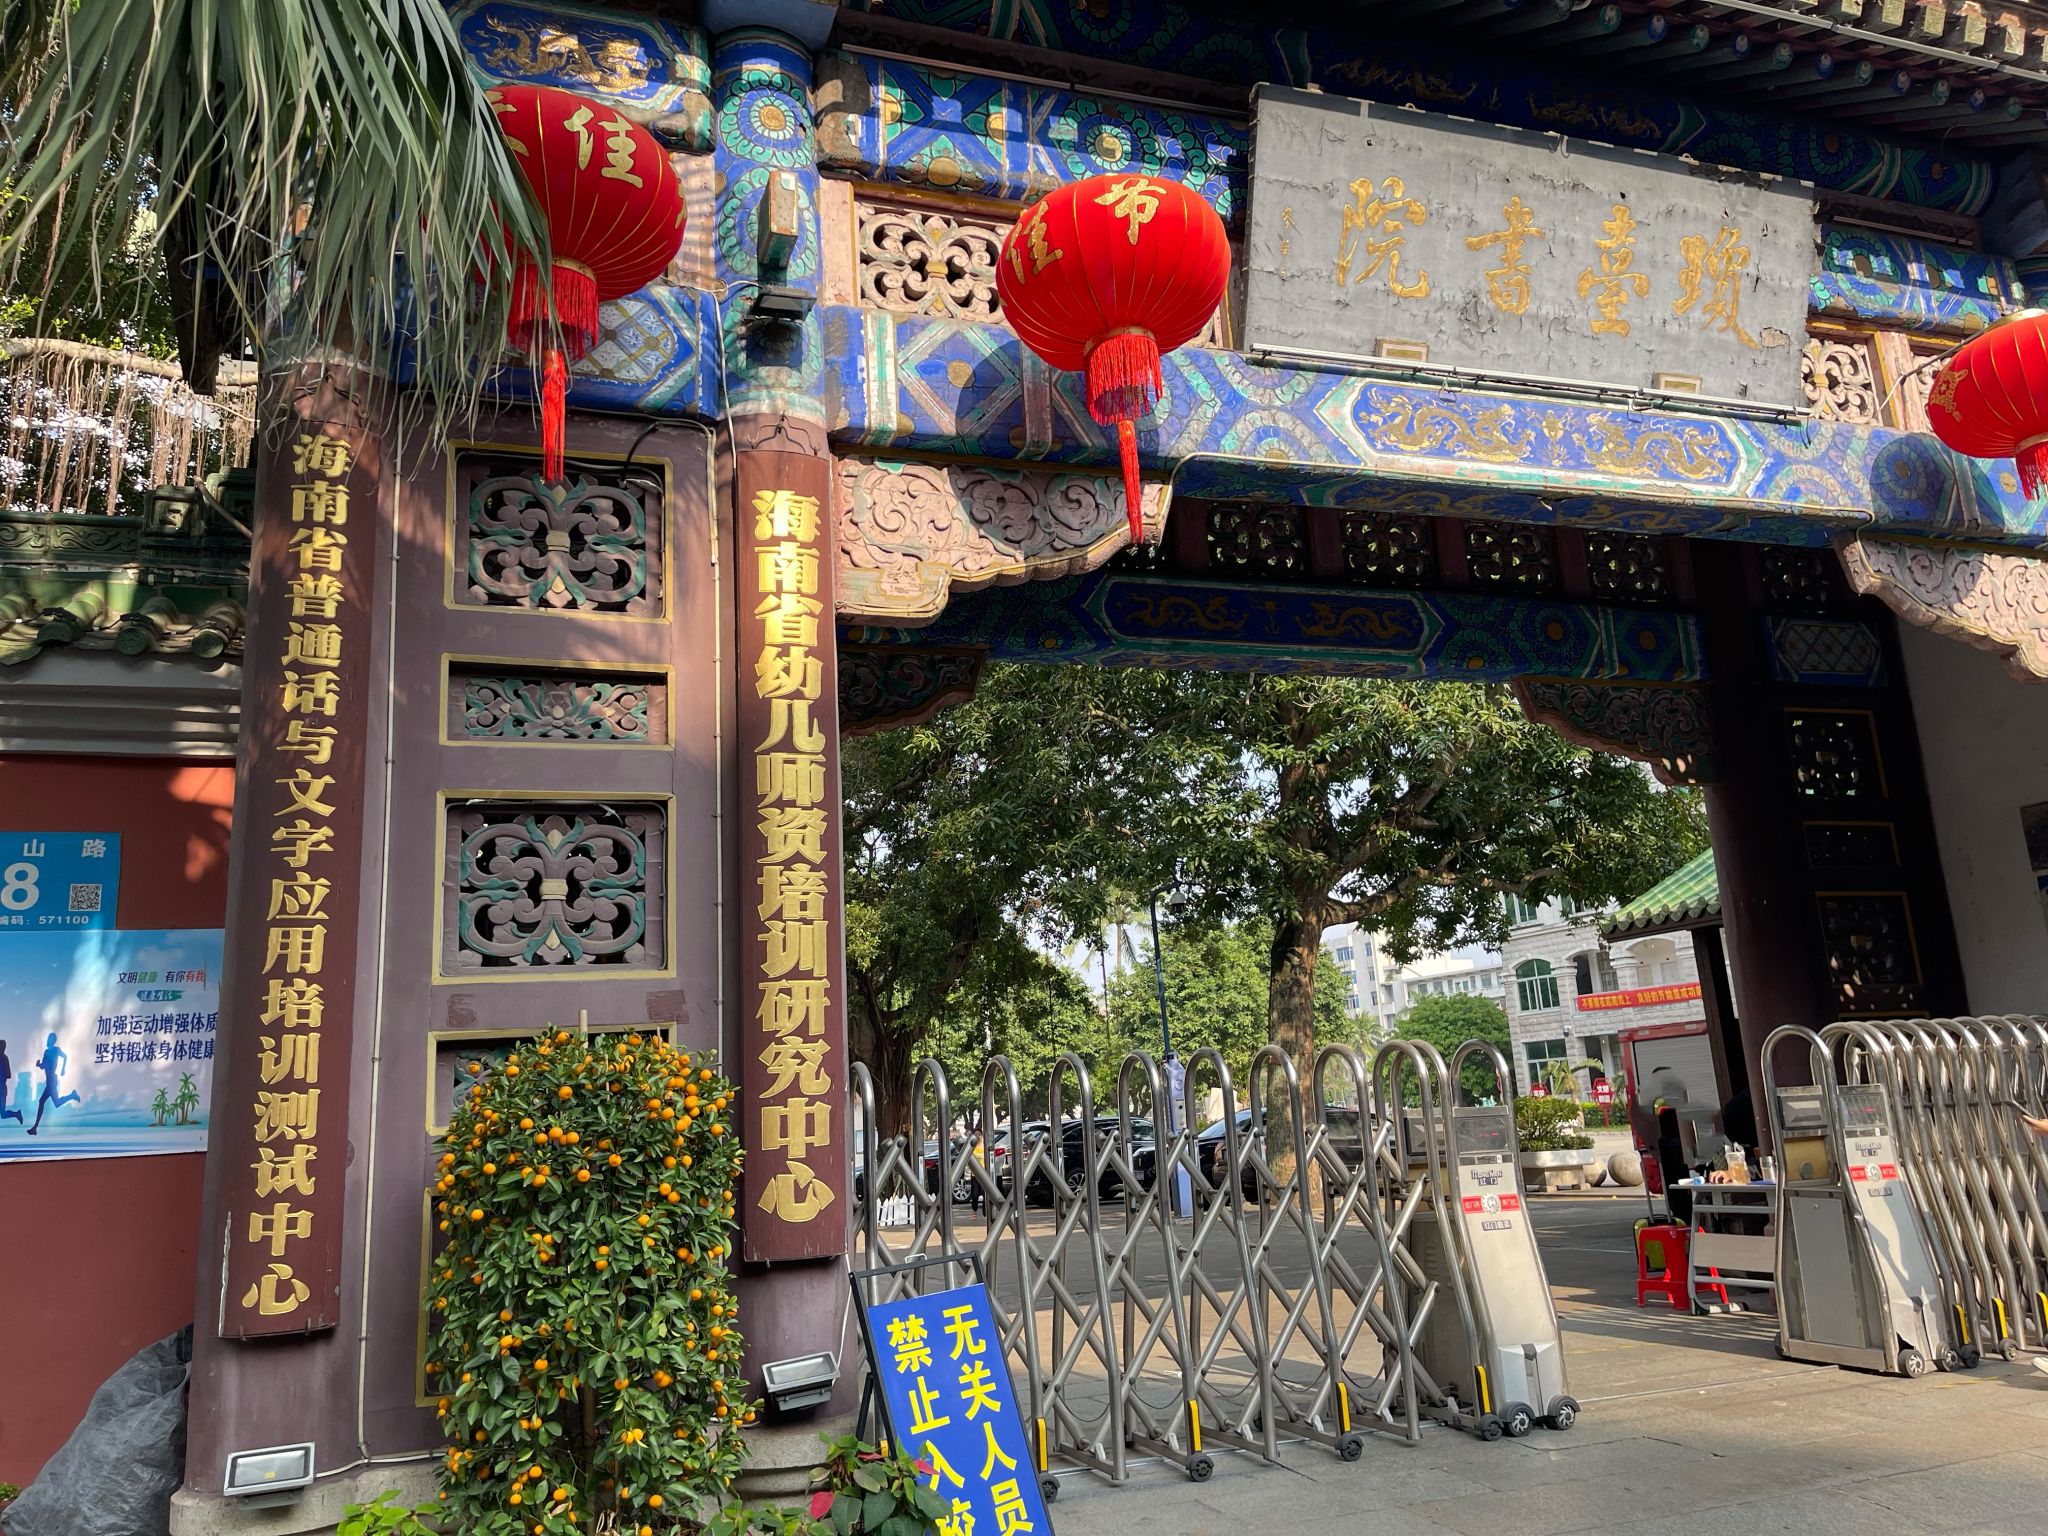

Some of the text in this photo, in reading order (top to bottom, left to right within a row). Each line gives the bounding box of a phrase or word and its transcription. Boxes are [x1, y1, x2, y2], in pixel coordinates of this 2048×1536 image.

[96, 1011, 218, 1036] 加强运动增强体质
[242, 434, 352, 1316] 海南省普通话与文字应用培训测试中心
[751, 489, 835, 1223] 海南省幼儿师资培训研究中心
[943, 1303, 1034, 1536] 无关人员
